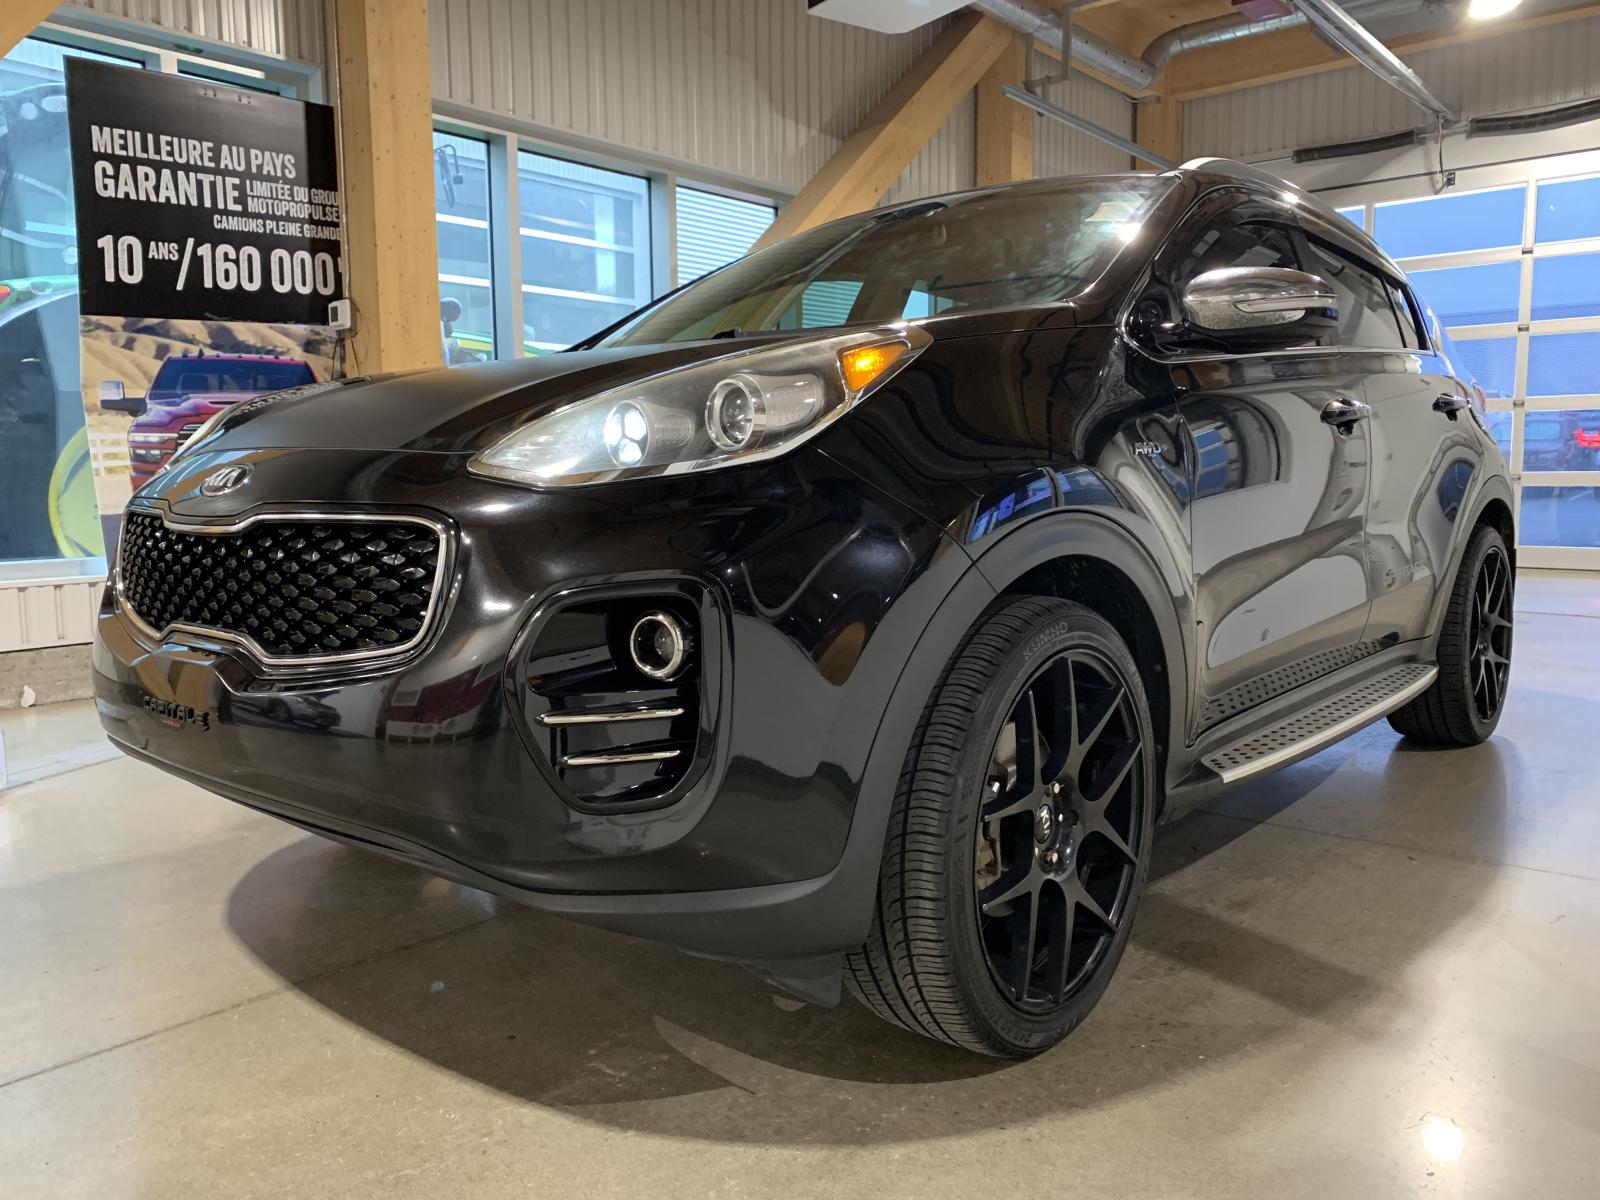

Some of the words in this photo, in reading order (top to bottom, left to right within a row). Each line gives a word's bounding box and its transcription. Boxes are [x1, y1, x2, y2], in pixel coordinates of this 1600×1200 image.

[91, 124, 215, 168] MEILLEURE
[220, 144, 245, 172] AU
[250, 148, 296, 179] PAYS
[94, 160, 242, 212] GARANTIE
[246, 179, 292, 201] LIMITÉE
[293, 185, 309, 202] DU
[213, 214, 264, 234] CAMIONS
[266, 219, 302, 236] PLEINE
[97, 234, 143, 284] 10
[148, 241, 179, 261] ANS
[1135, 441, 1161, 455] AWD
[203, 467, 243, 487] KIA
